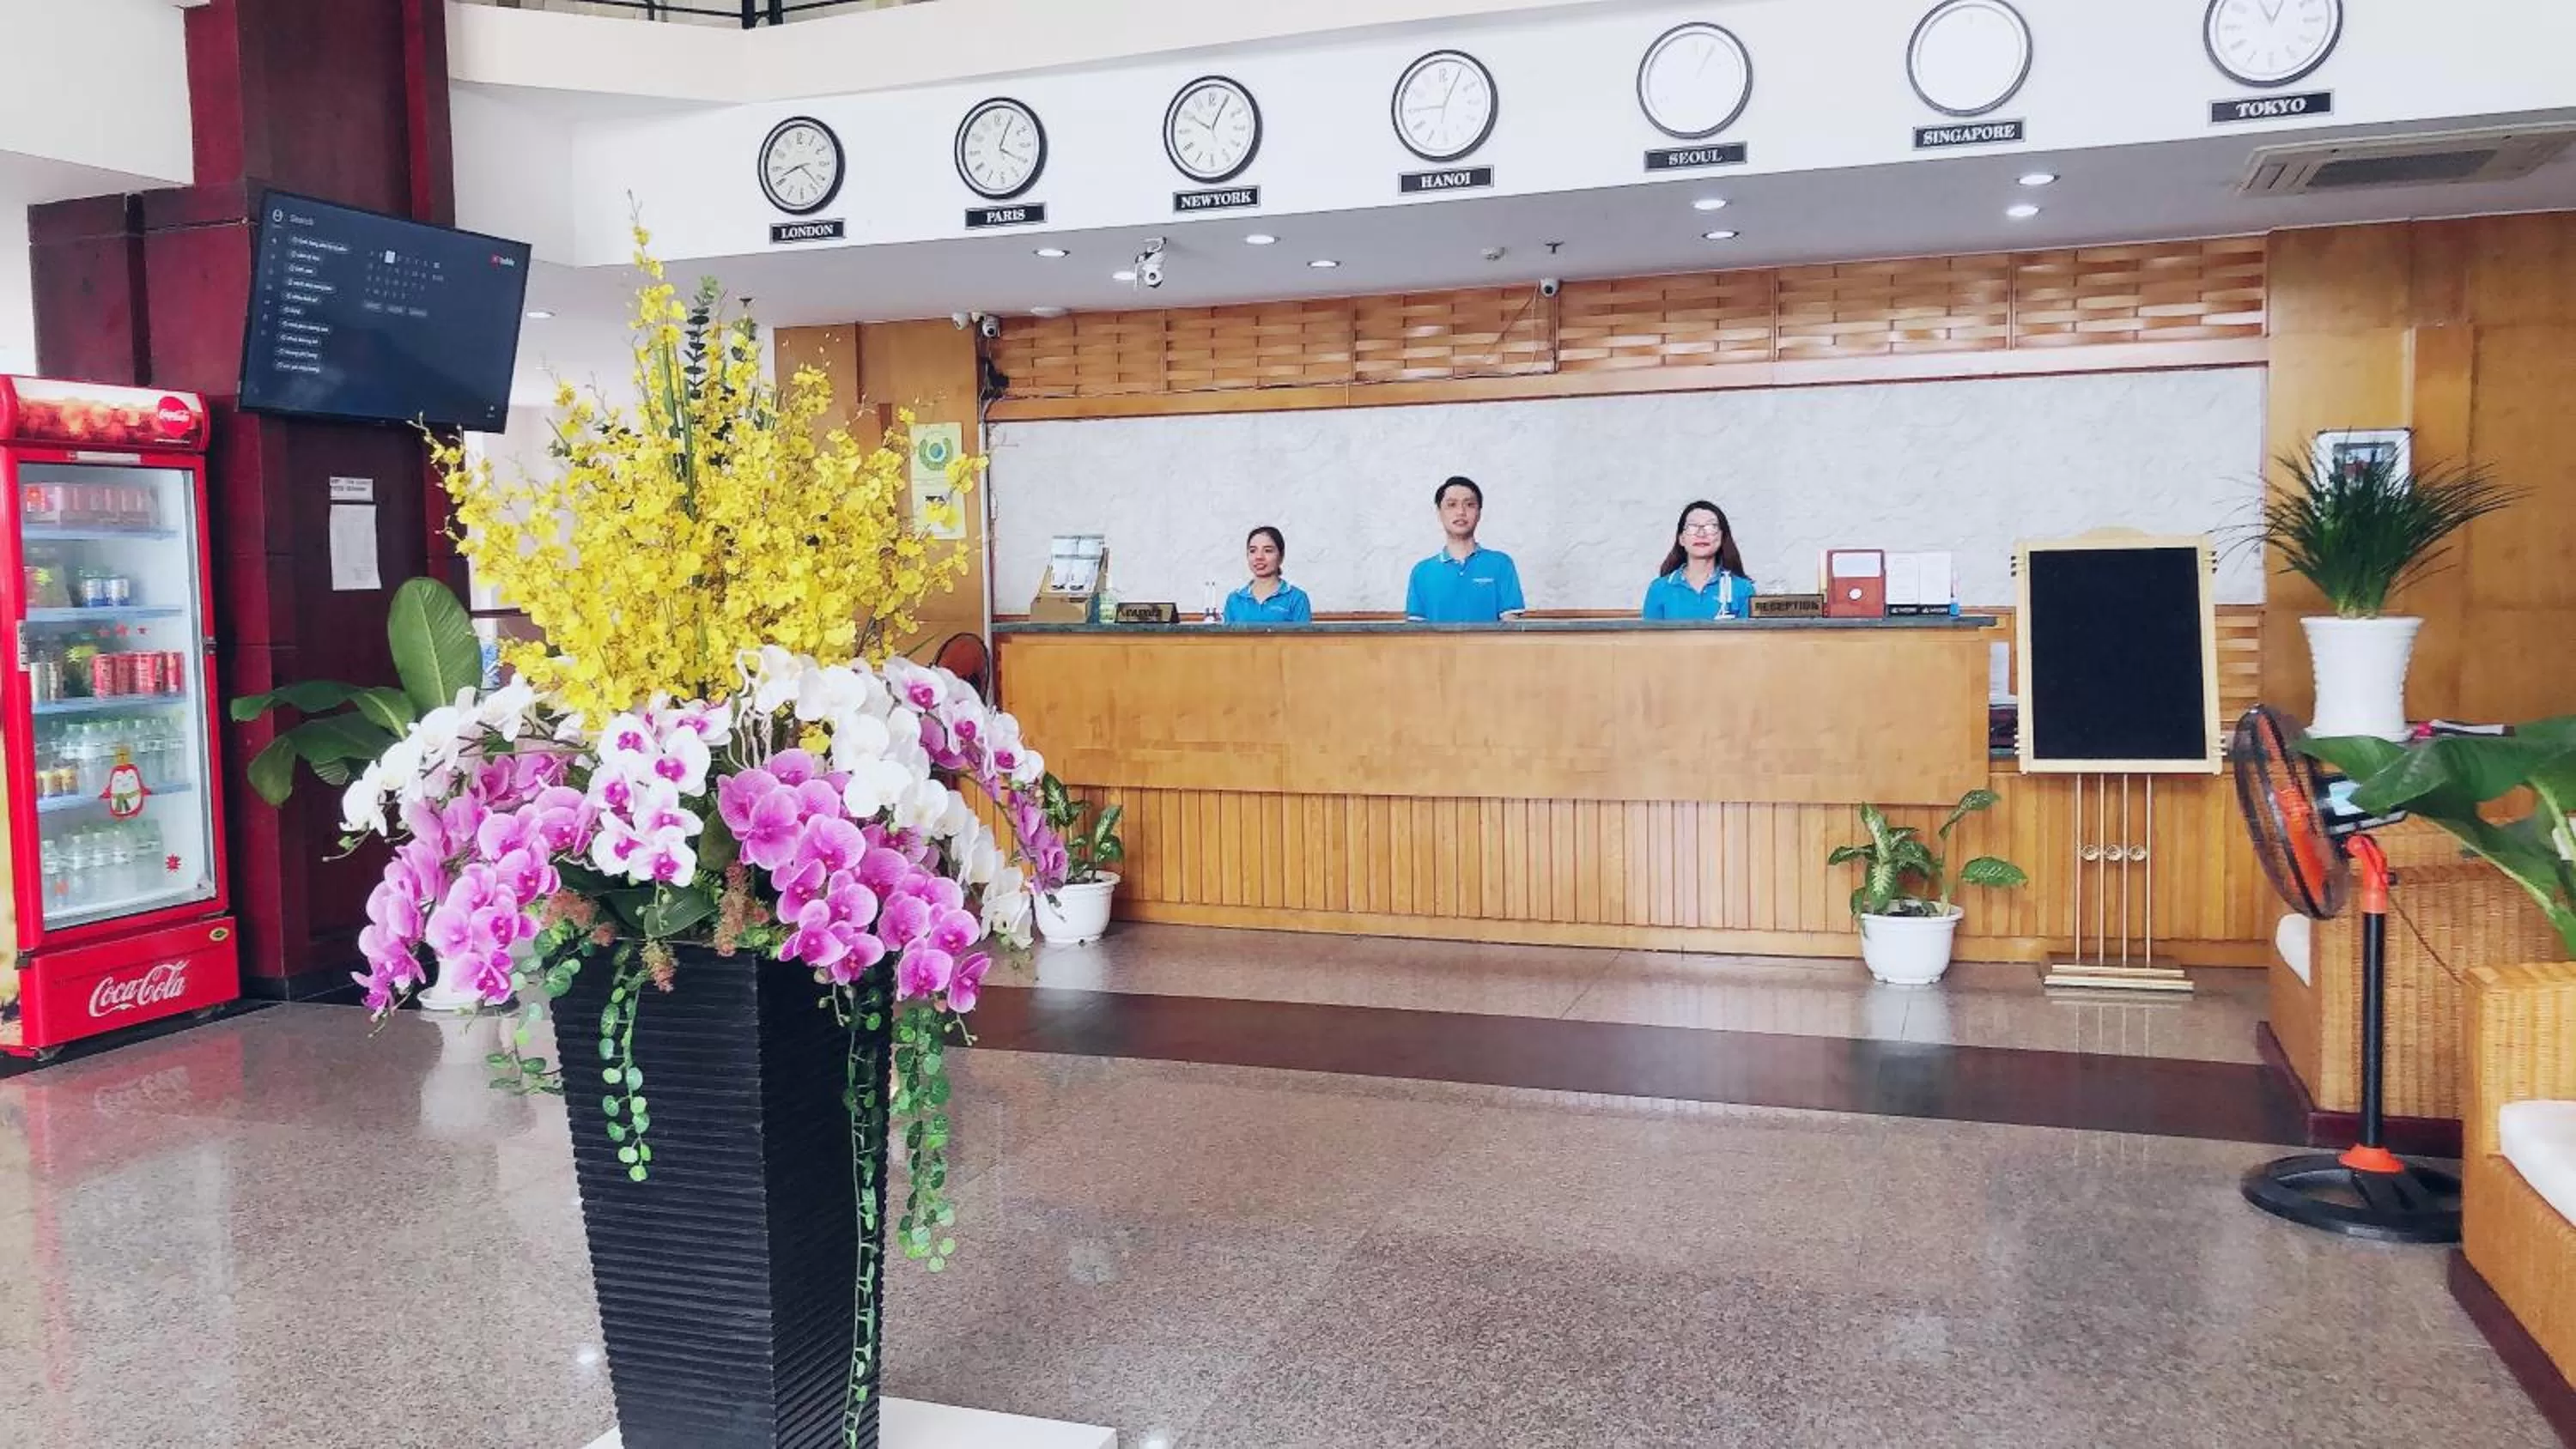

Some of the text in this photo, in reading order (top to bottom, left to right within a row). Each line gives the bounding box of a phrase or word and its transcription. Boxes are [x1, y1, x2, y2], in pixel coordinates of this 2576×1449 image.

[2235, 97, 2307, 118] TOKYO
[1923, 124, 2016, 145] SINGAPORE
[1668, 149, 1723, 166] SEOUL
[1420, 172, 1471, 188] HANOI
[1181, 190, 1253, 209] NEWYORK
[987, 209, 1026, 223] PARIS
[780, 224, 835, 239] LONDON
[88, 959, 191, 1017] Coca-Cola
